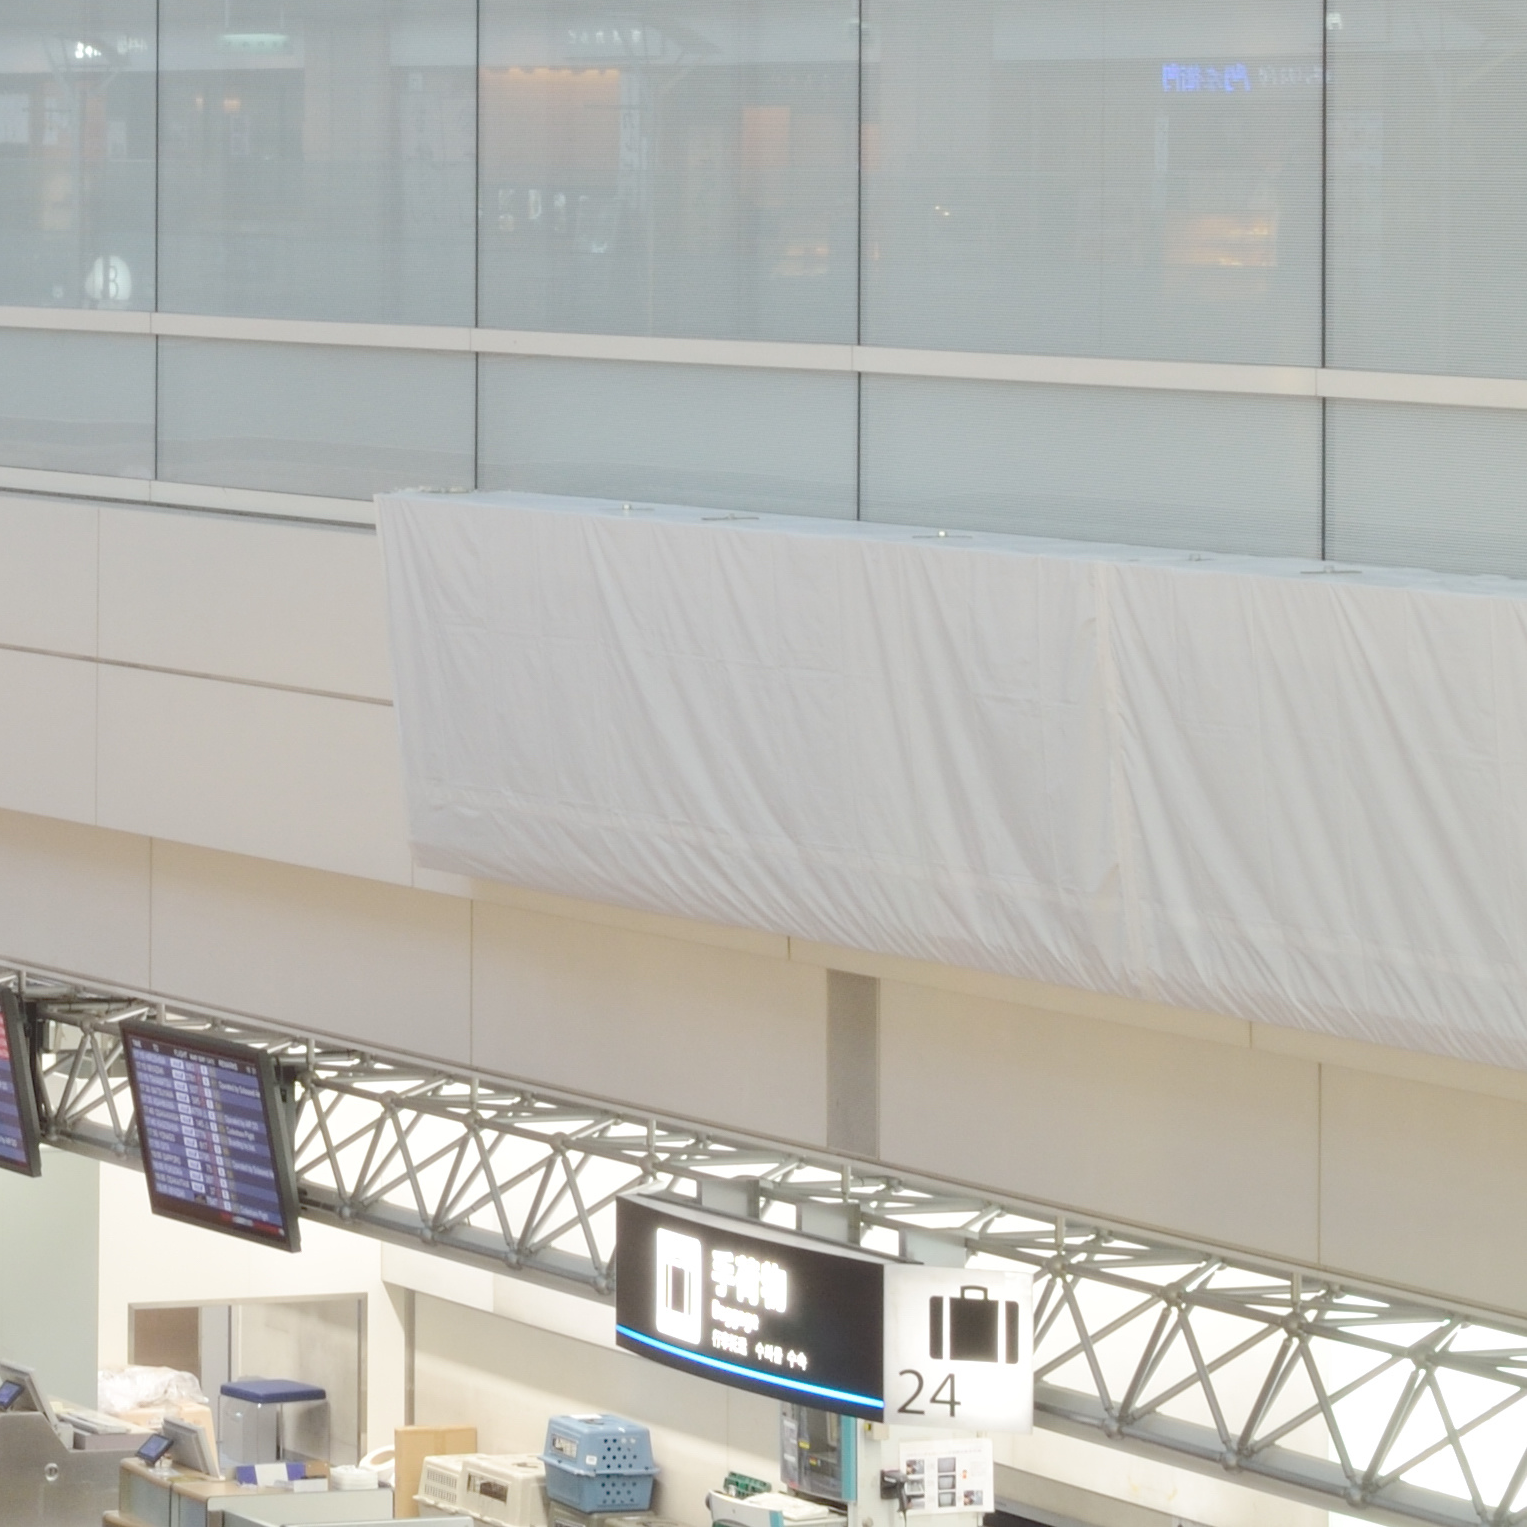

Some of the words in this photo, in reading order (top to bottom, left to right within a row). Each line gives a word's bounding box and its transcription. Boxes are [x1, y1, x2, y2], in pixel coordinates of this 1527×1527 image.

[711, 1250, 788, 1313] 手荷物
[898, 1369, 961, 1418] 24
